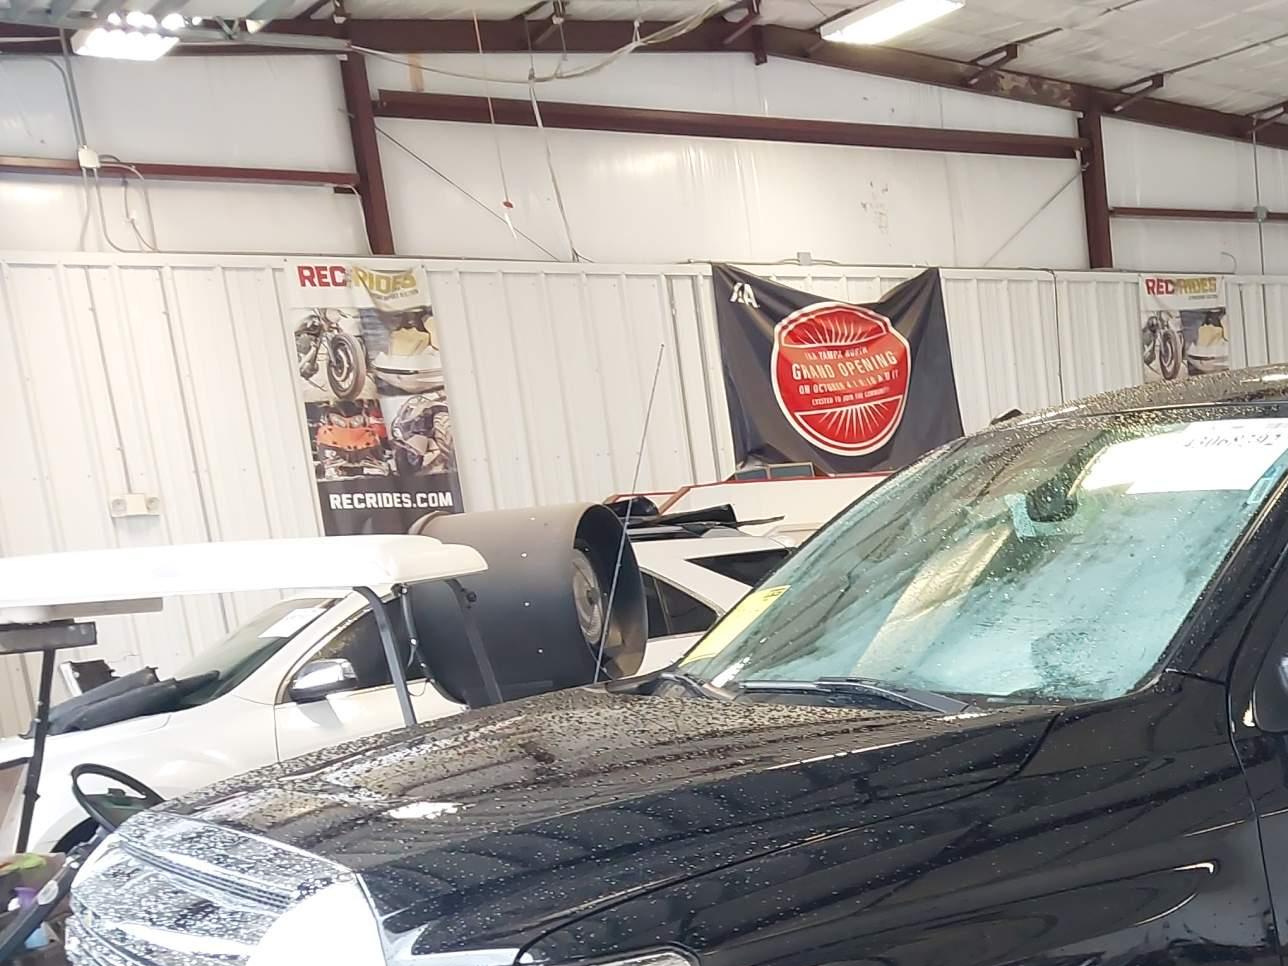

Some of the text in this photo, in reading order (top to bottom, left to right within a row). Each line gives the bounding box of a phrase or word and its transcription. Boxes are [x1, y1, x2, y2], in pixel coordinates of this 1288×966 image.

[297, 265, 347, 287] REC
[1145, 278, 1175, 295] REC
[818, 350, 843, 361] TAMPA
[792, 363, 836, 380] GRAND
[838, 350, 898, 377] OPENING
[798, 385, 811, 395] ON
[328, 492, 453, 510] RECRIDES.COM
